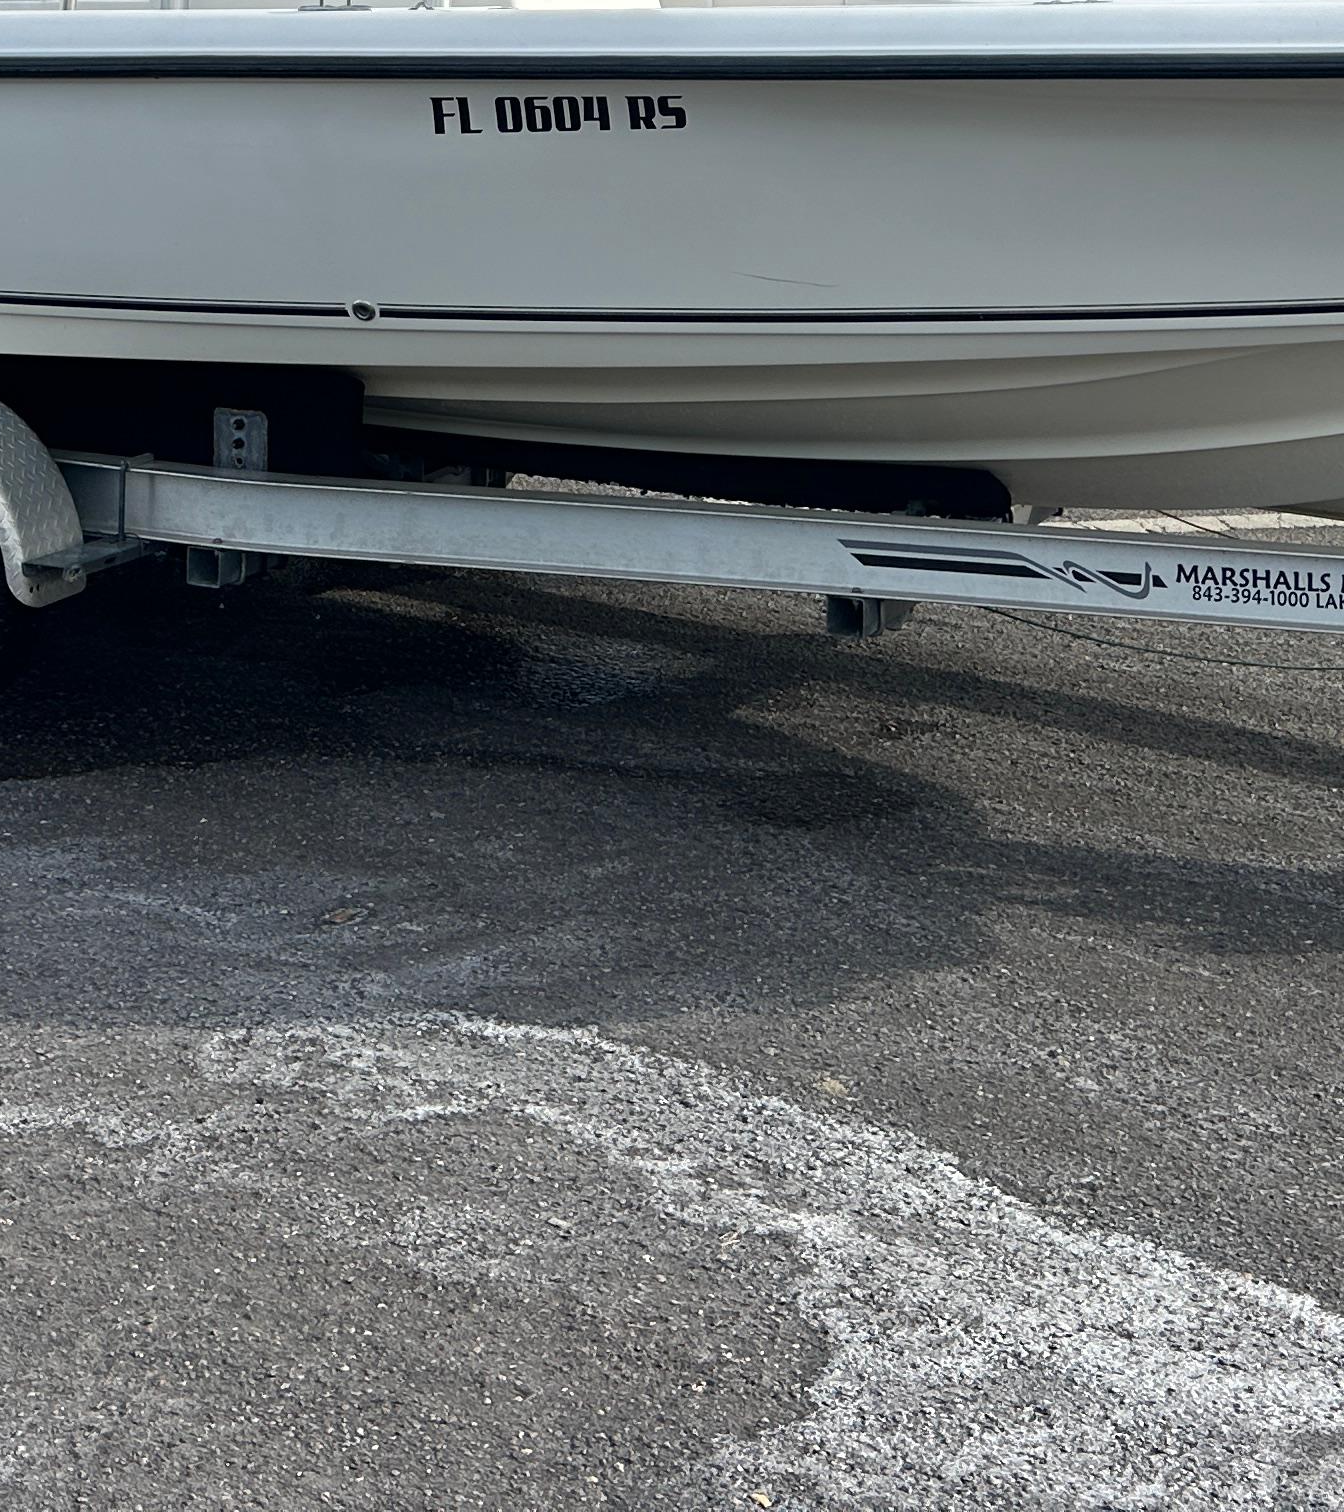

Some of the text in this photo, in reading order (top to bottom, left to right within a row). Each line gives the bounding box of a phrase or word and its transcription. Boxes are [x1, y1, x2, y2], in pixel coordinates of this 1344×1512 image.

[429, 95, 687, 135] FL 0604 RS
[1175, 563, 1331, 593] MARSHALLS
[1192, 585, 1310, 608] 843-394-1000
